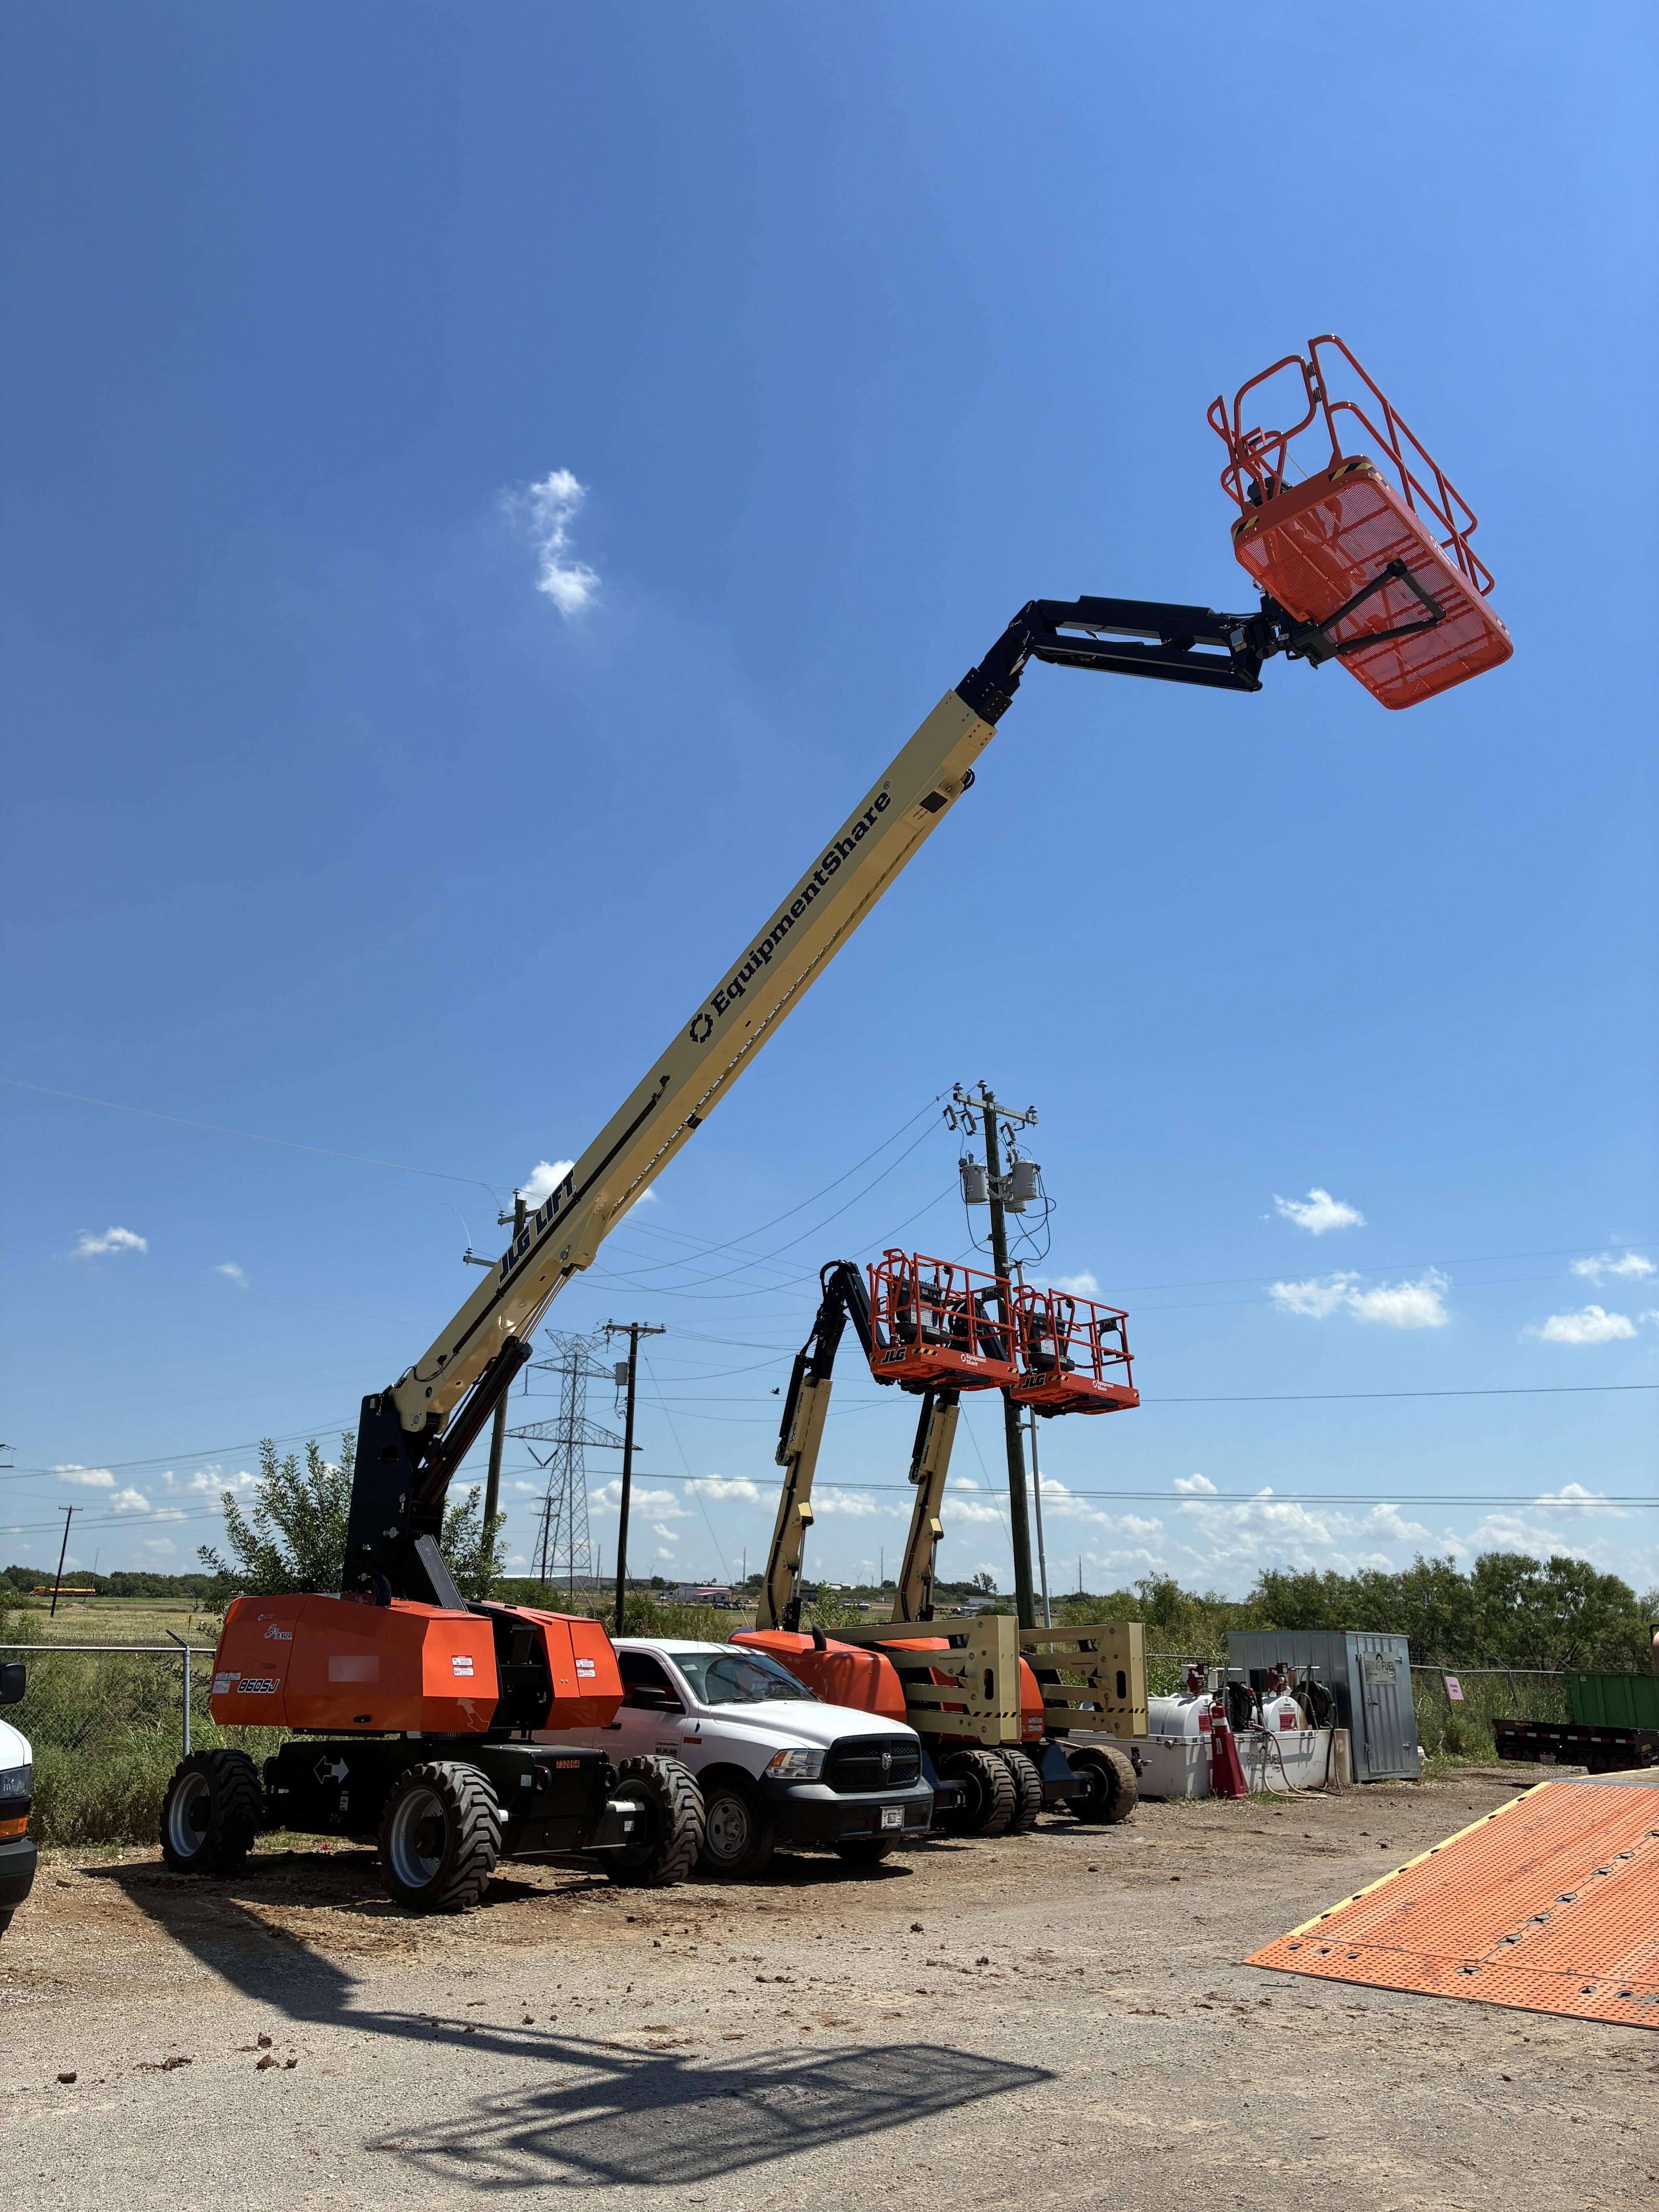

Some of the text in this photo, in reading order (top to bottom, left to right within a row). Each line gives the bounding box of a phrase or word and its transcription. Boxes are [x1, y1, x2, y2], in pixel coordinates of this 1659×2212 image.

[499, 1168, 575, 1284] JLG LIFT
[881, 1347, 906, 1365] JLG
[1021, 1374, 1046, 1390] JLG
[1382, 1661, 1395, 1670] FUEL
[237, 1679, 280, 1693] 860SJ
